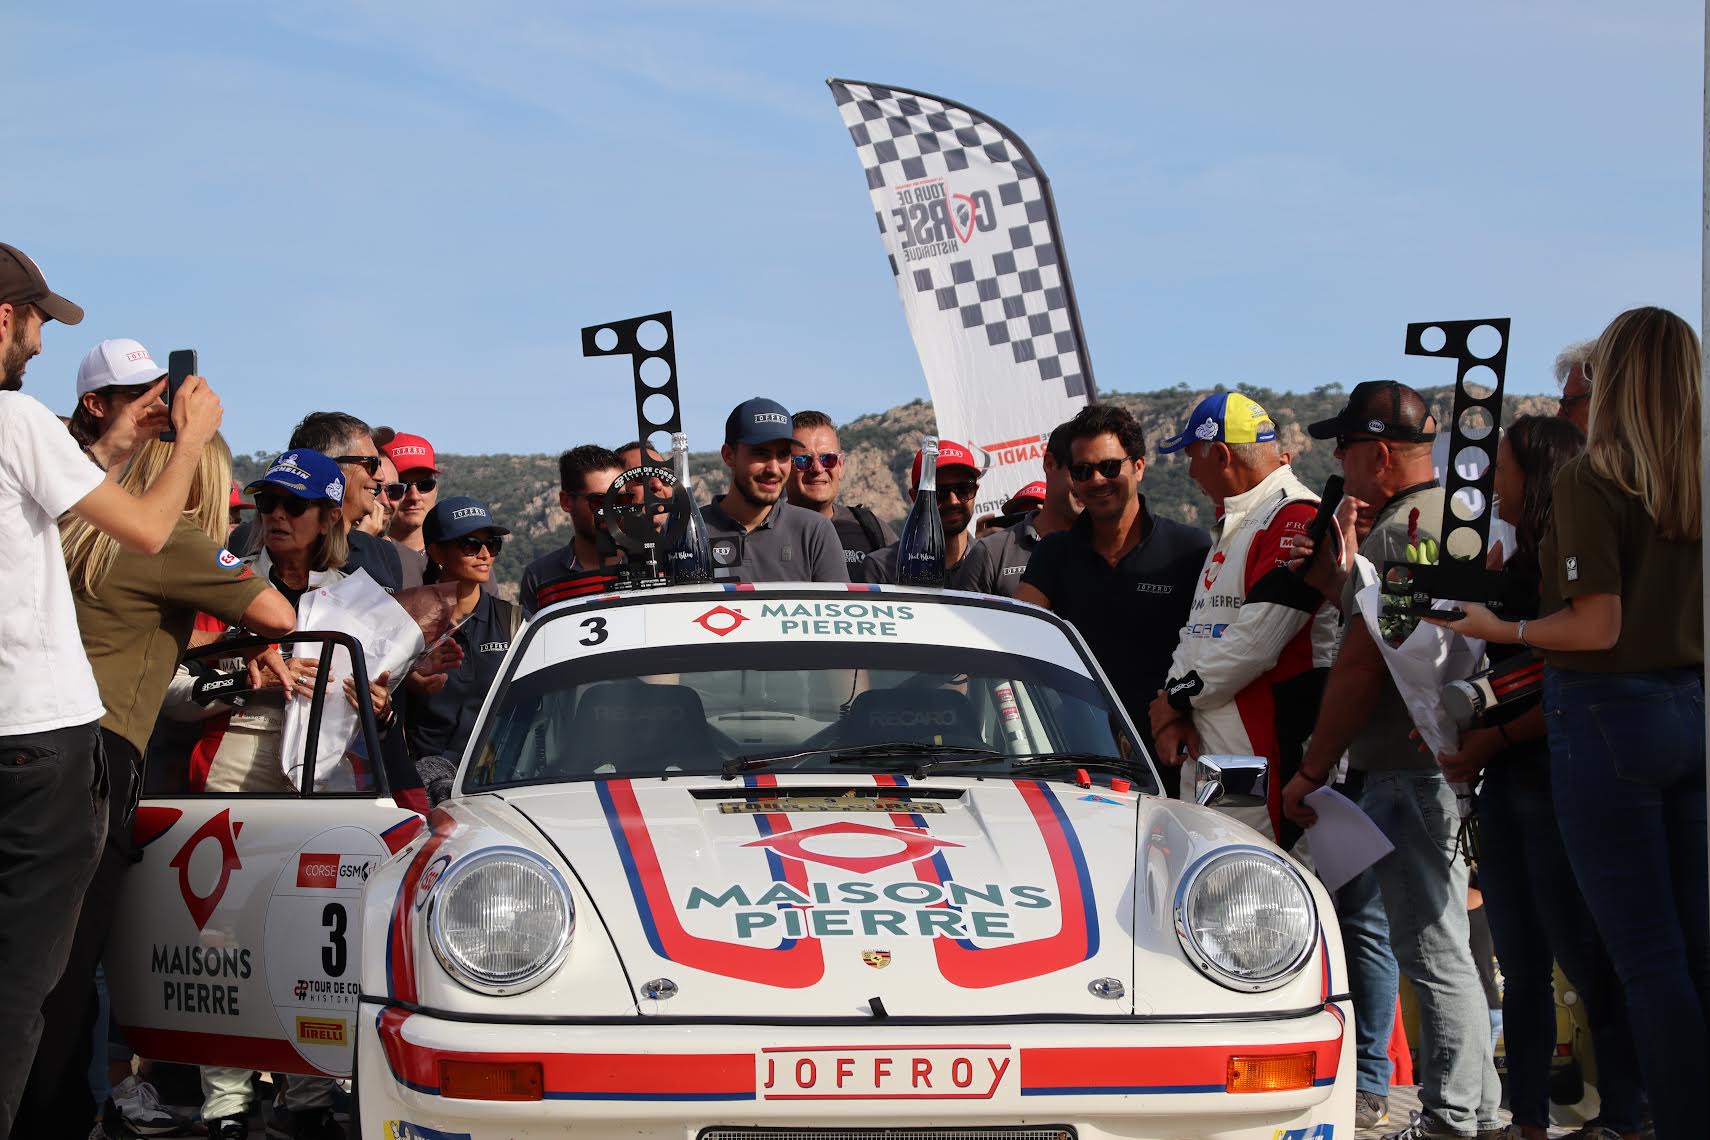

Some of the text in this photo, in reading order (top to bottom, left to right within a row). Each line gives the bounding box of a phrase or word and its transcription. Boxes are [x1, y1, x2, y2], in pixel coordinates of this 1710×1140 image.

[622, 467, 642, 478] TOUR
[654, 468, 678, 483] CORSE
[713, 547, 731, 556] ROY
[761, 603, 914, 620] MAISONS
[578, 616, 609, 647] 3
[781, 620, 898, 637] PIERRE
[480, 642, 509, 652] JOFFRO
[201, 678, 235, 692] sparco
[305, 864, 337, 878] CORSE
[339, 864, 362, 878] GSM
[685, 881, 1052, 910] MAISONS
[735, 910, 1015, 939] PIERRE
[321, 902, 346, 978] 3
[151, 944, 252, 980] MAISONS
[309, 980, 331, 993] TOUR
[334, 982, 346, 994] DE
[163, 981, 239, 1016] PIERRE
[310, 994, 355, 1004] HISTORI
[299, 1021, 343, 1041] PIRELLI
[763, 1056, 1011, 1091] JOFFROY
